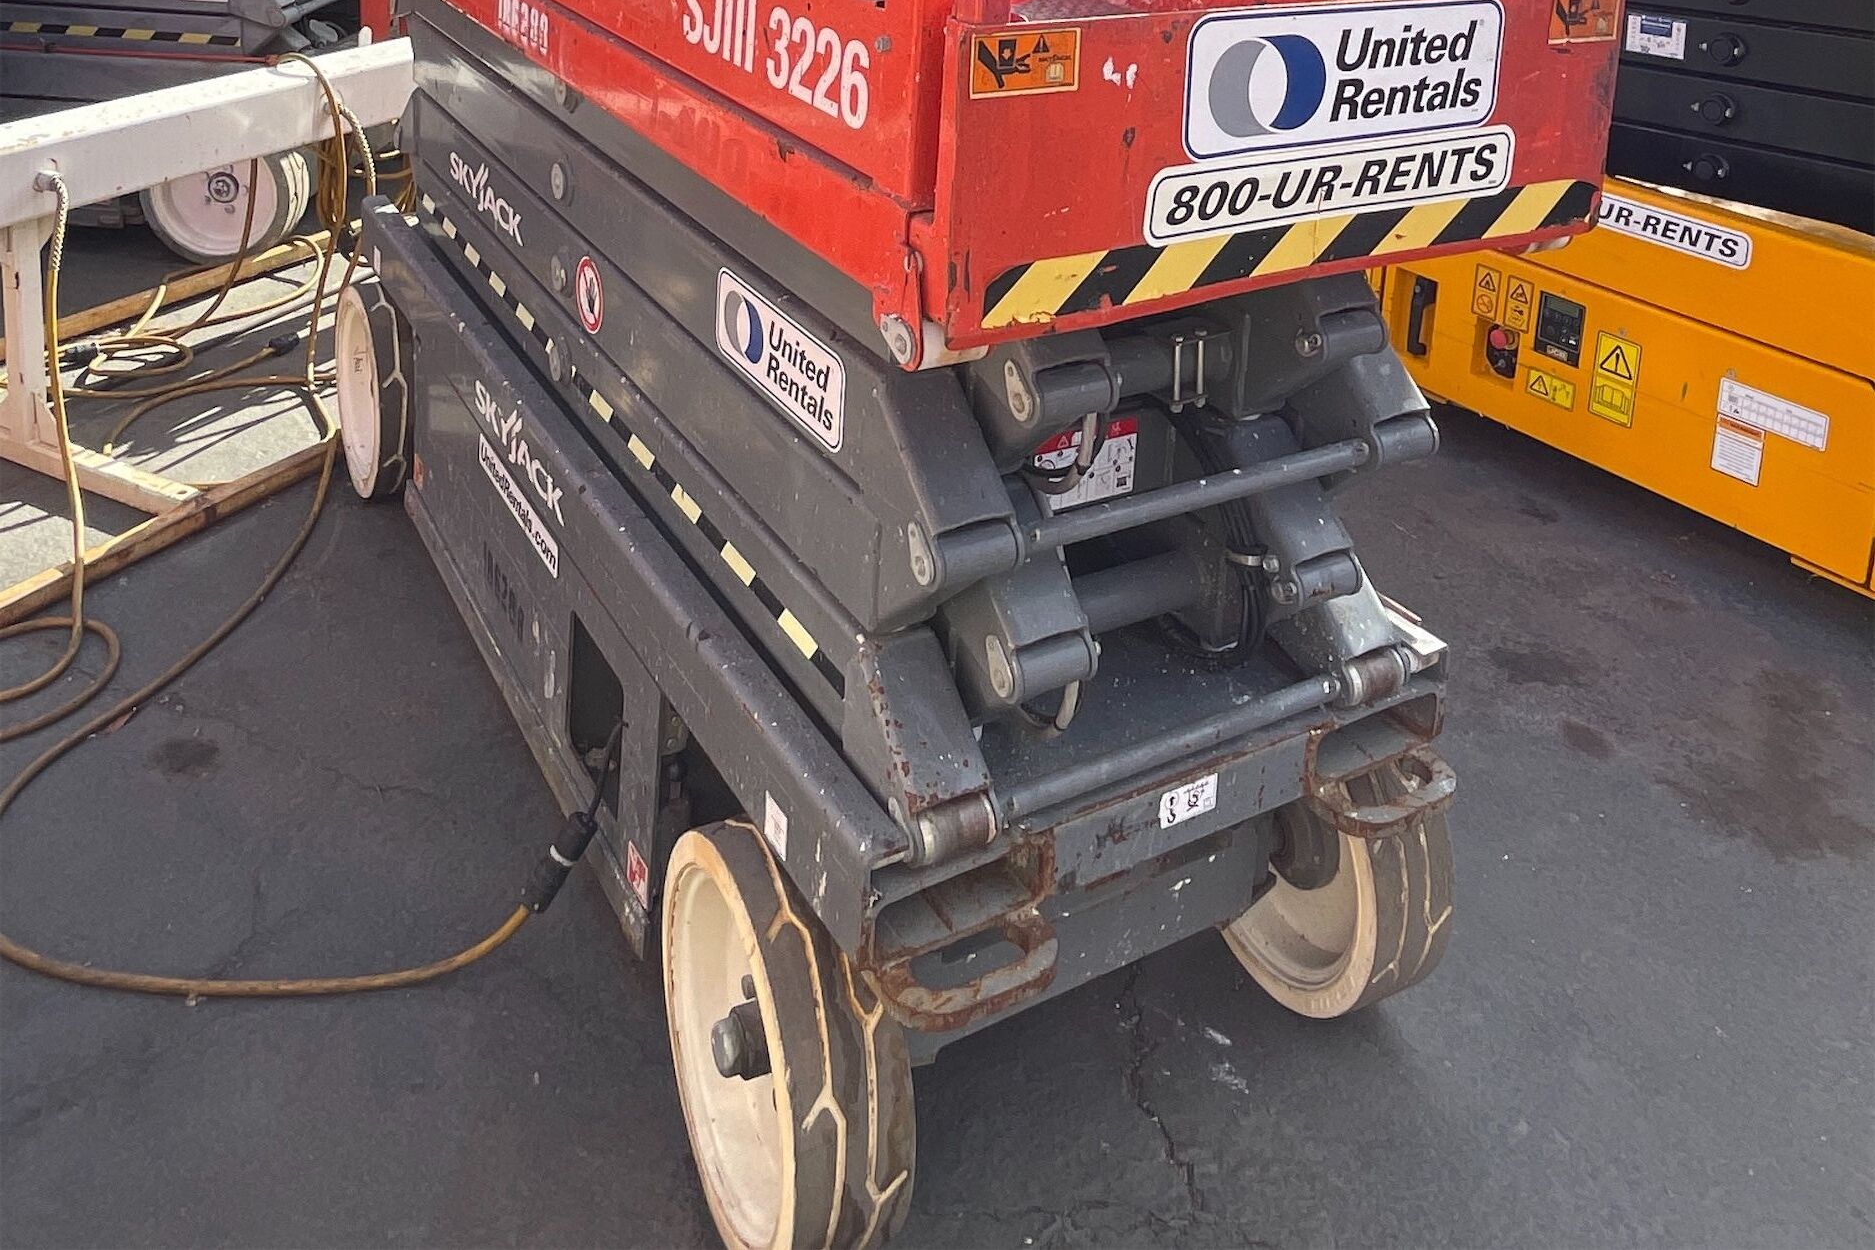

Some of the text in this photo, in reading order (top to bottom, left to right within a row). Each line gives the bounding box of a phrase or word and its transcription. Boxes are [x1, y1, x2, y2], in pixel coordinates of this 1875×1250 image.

[765, 6, 871, 130] 3226
[1335, 19, 1479, 72] United
[1329, 67, 1483, 124] Rentals
[449, 152, 524, 247] SKYJACK
[1166, 141, 1498, 227] 800-UR-RENTS
[767, 353, 834, 431] Rentals
[769, 319, 831, 394] United
[475, 379, 565, 527] SKYJACK
[480, 441, 557, 570] UnitedRentals.com
